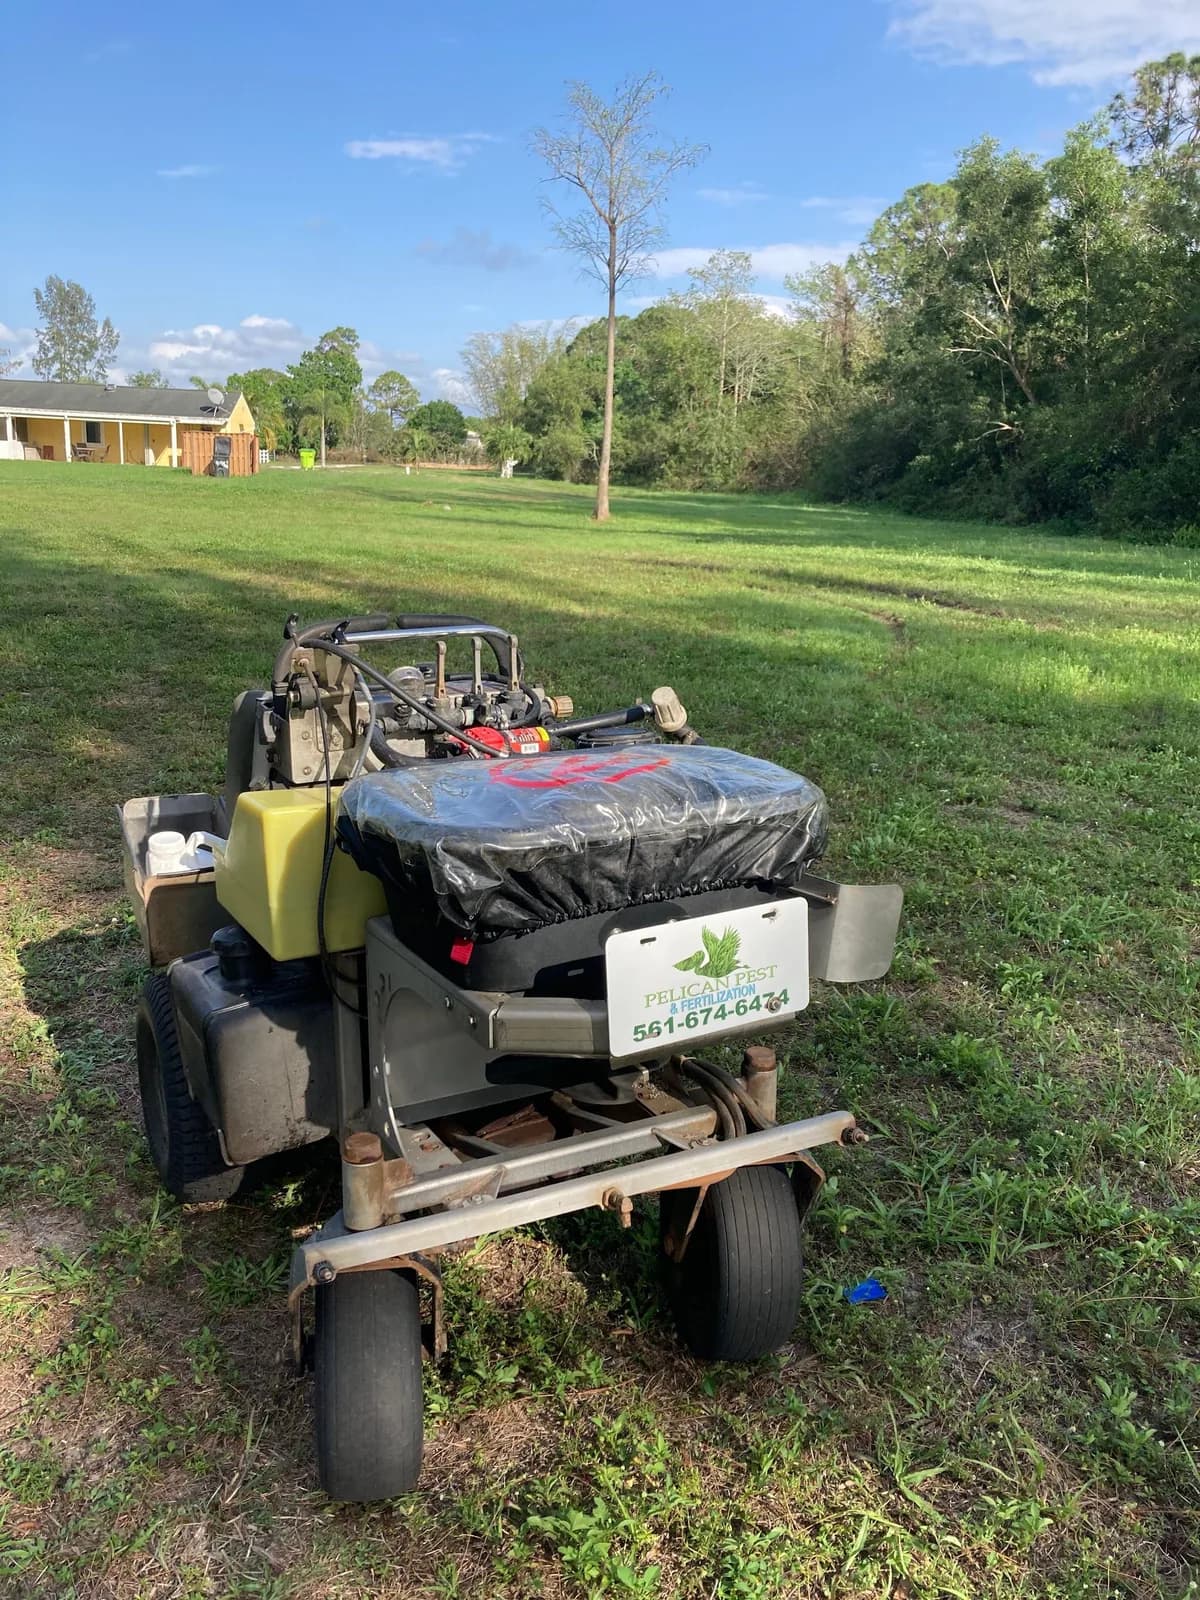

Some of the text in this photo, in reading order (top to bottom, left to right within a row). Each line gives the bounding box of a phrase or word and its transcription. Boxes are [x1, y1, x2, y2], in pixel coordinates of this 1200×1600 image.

[644, 965, 778, 1008] PELICAN PEST
[669, 984, 756, 1015] & FERTILIZATION
